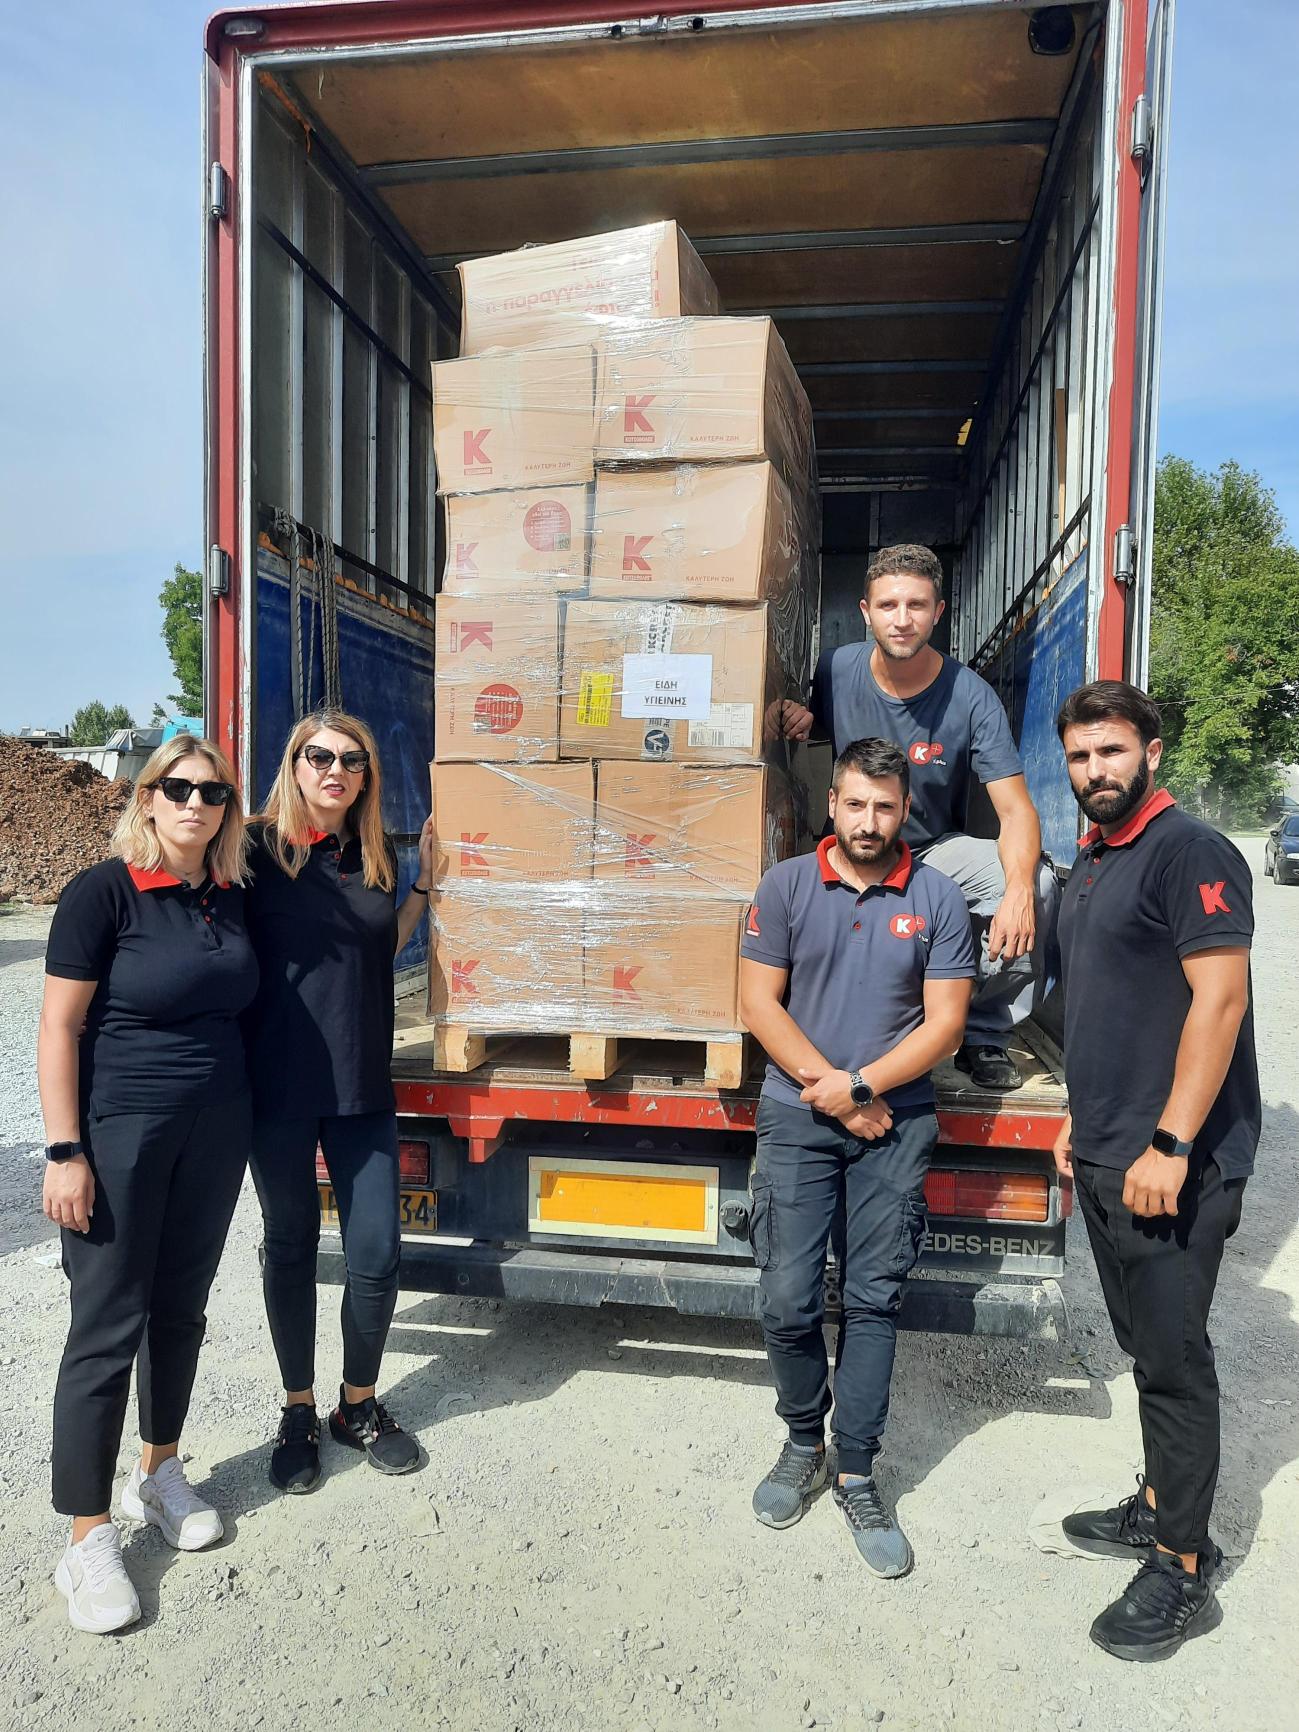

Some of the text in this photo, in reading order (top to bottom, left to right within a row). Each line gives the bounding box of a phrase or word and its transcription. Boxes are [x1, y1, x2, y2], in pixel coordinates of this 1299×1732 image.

[624, 394, 657, 432] K
[463, 428, 493, 465] K
[456, 542, 480, 570] K
[622, 535, 655, 570] K
[460, 621, 493, 653] K
[644, 696, 687, 706] ΥΓΙΕΙΝΗΣ
[655, 680, 678, 689] ΕΙΔΗ
[914, 746, 929, 761] K
[460, 832, 490, 867] K
[624, 833, 657, 868] K
[1198, 881, 1232, 915] K
[896, 918, 912, 934] K
[451, 959, 481, 993] K
[611, 965, 644, 1001] K
[400, 1195, 430, 1226] 34
[924, 1232, 1055, 1257] EDES-BENZ
